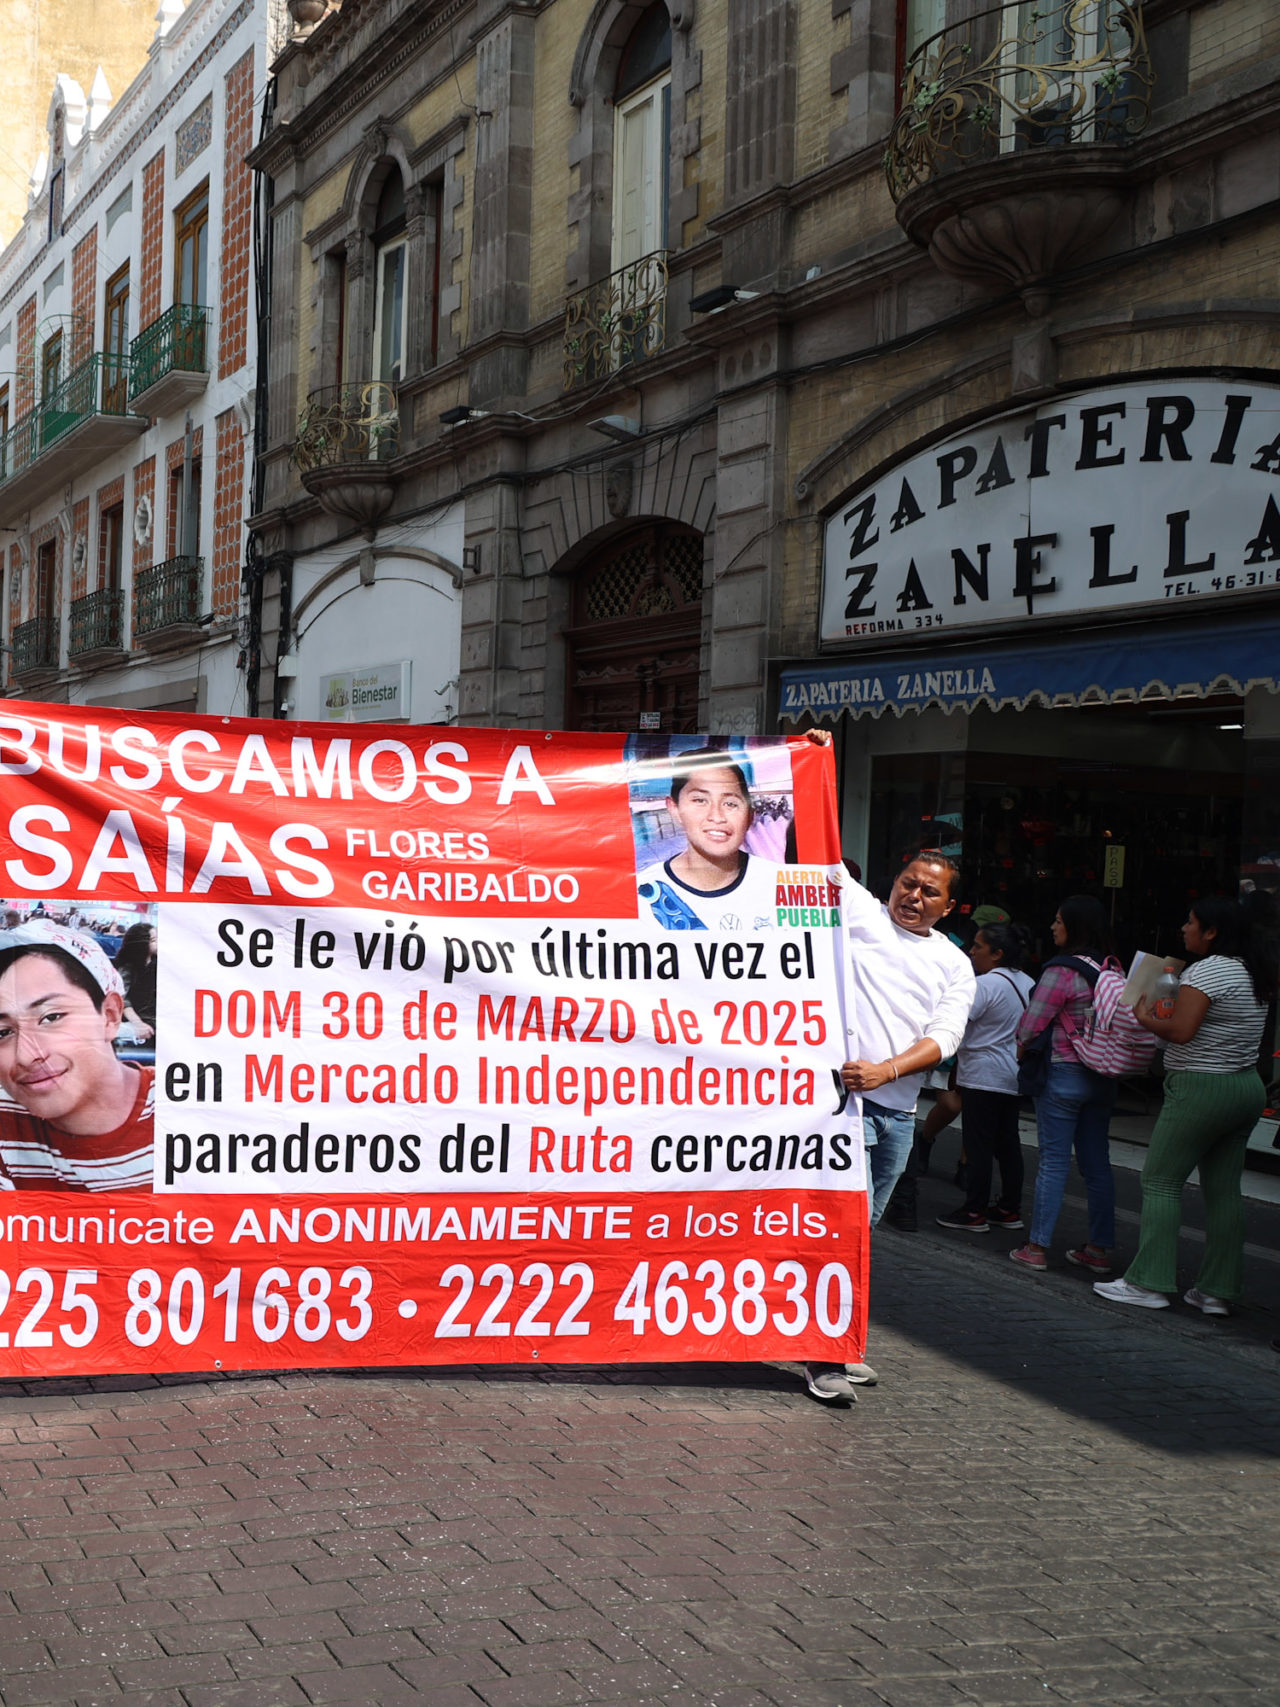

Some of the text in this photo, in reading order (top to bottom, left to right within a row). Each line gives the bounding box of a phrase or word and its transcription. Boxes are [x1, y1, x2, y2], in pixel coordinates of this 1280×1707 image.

[844, 492, 1280, 618] ZANELLA
[1164, 581, 1200, 597] TEL.
[845, 614, 943, 635] REFORMA 334
[352, 685, 397, 704] Bienestar
[785, 667, 996, 706] ZAPATERIA ZANELLA
[496, 745, 556, 805] A
[346, 829, 490, 860] FLORES
[362, 870, 579, 903] GARIBALDO
[775, 884, 840, 907] AMBER
[776, 870, 824, 884] ALERTA
[777, 908, 841, 927] PUEBLA
[216, 919, 815, 983] Se le vió por última vez el
[194, 989, 827, 1046] DOM 30 de MARZO de 2025
[165, 1061, 222, 1102] en
[245, 1053, 459, 1104] Mercado
[478, 1054, 815, 1116] Independencia
[165, 1122, 852, 1185] paraderos del Ruta cercanas
[229, 1206, 632, 1243] ANONIMAMENTE
[646, 1213, 669, 1238] a
[684, 1205, 739, 1237] los
[752, 1203, 840, 1238] tels.
[124, 1266, 374, 1347] 801683
[434, 1262, 594, 1338] 2222
[613, 1258, 854, 1338] 463830
